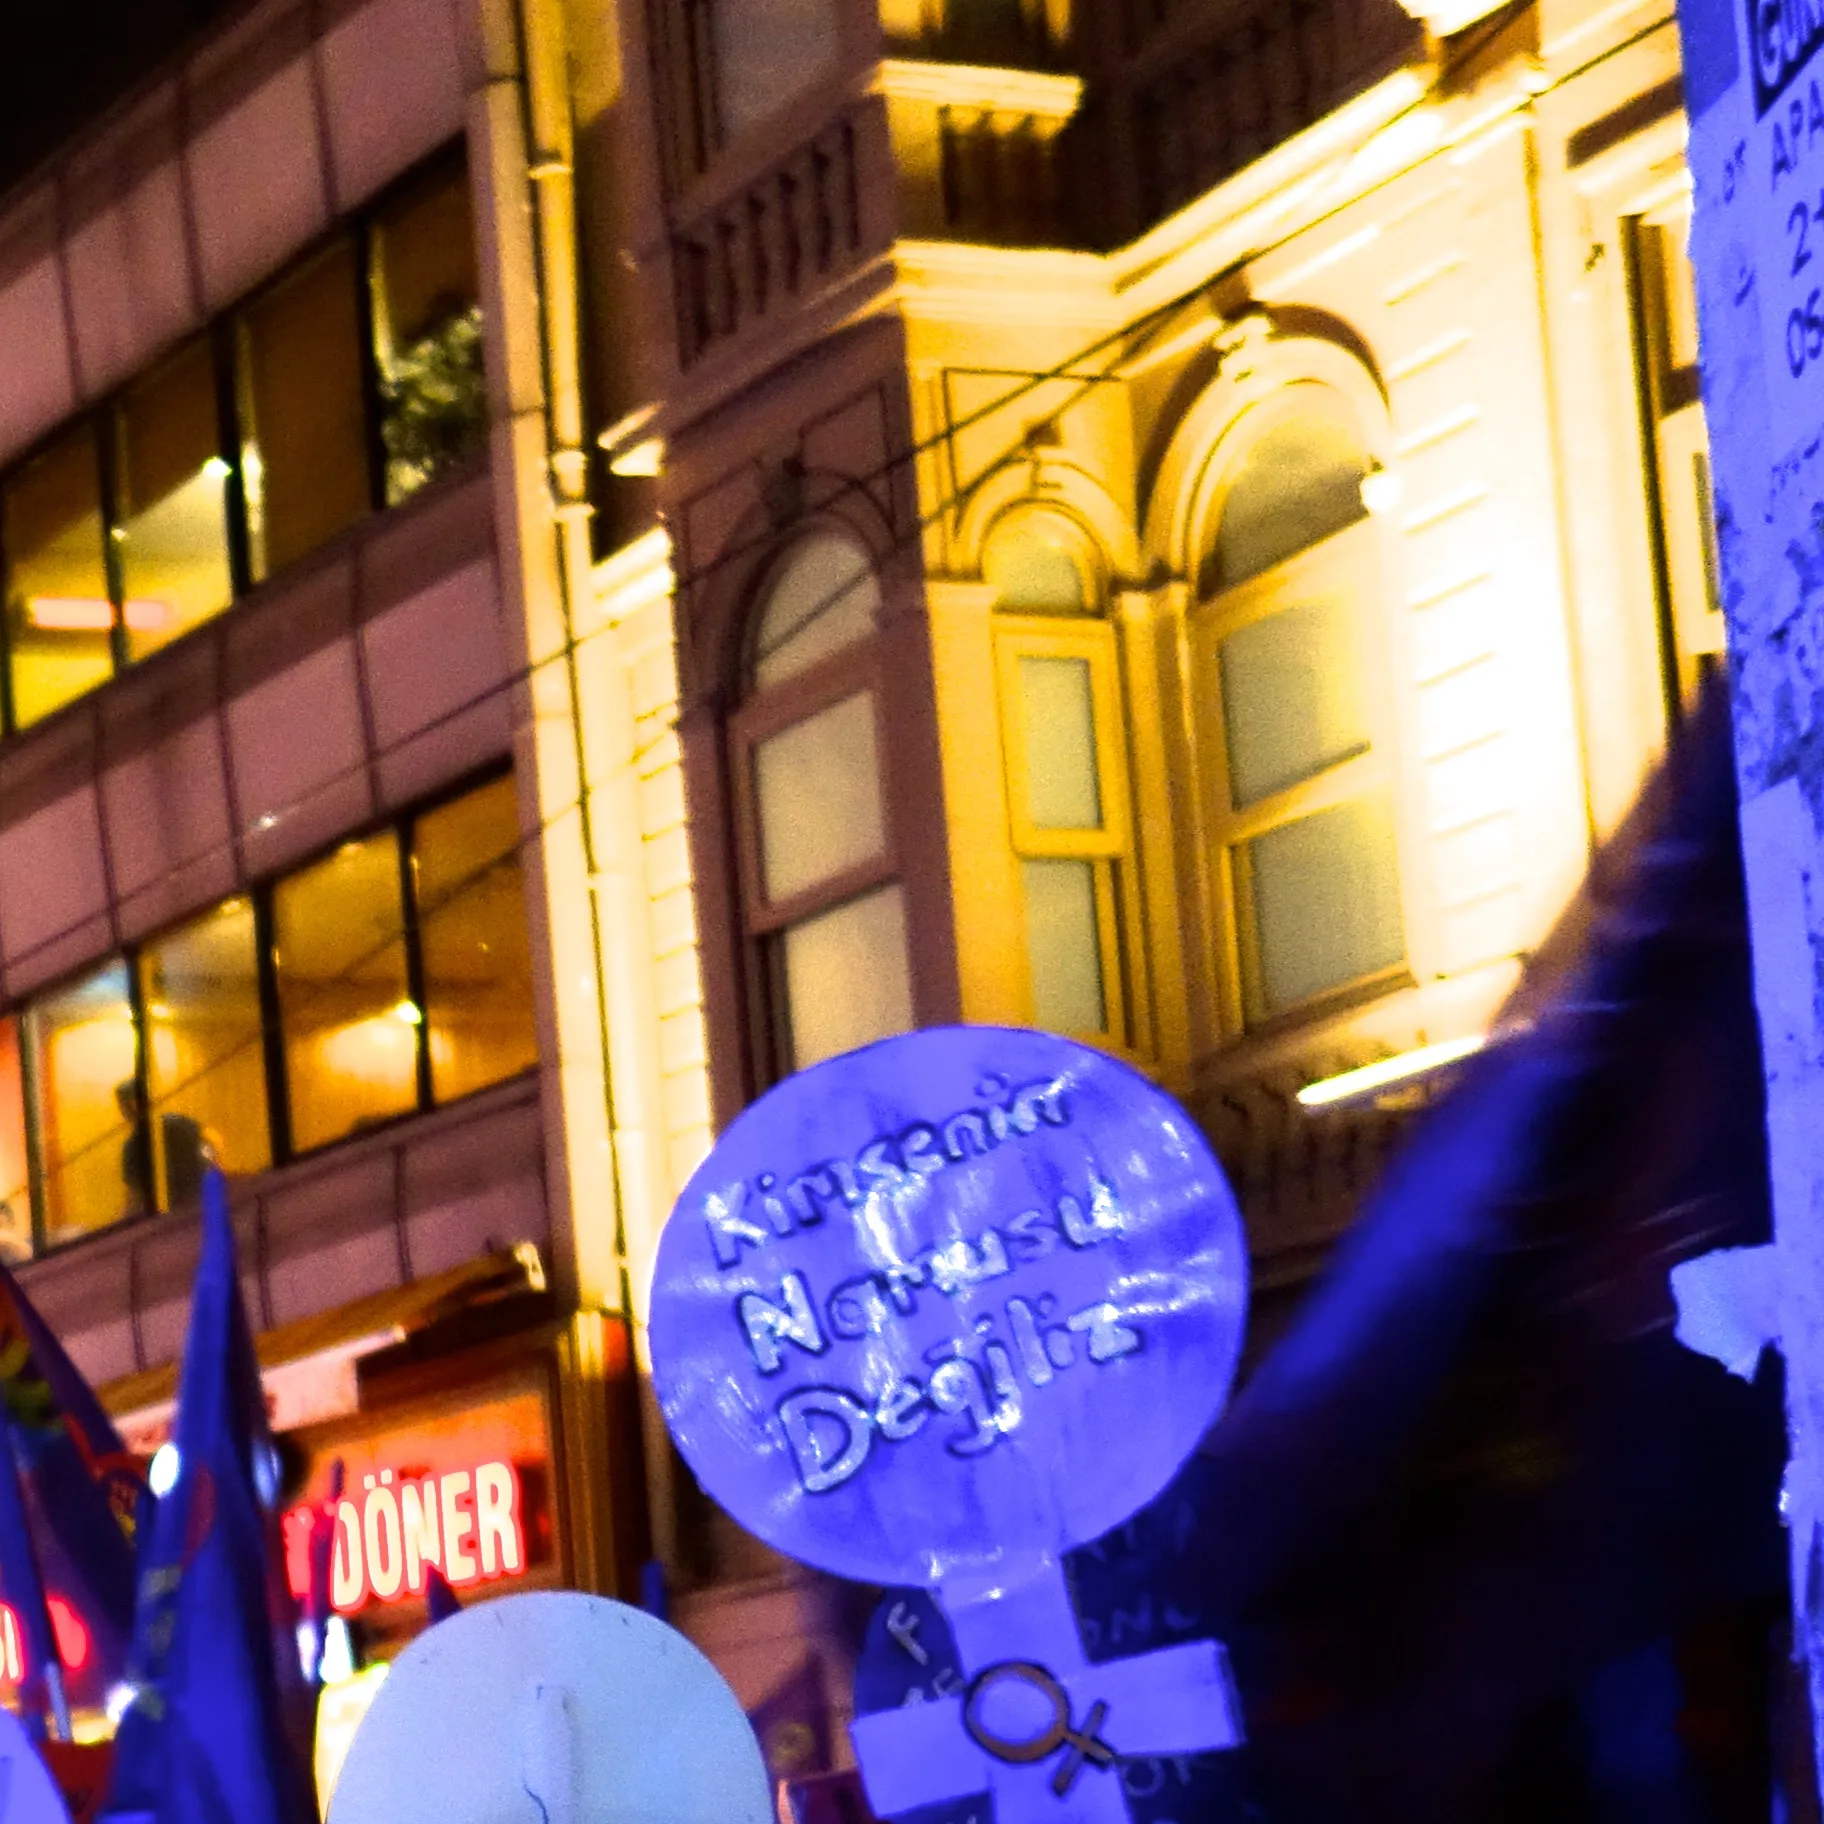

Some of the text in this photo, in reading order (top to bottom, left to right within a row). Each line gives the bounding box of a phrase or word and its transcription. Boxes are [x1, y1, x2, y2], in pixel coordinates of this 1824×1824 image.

[705, 1070, 1074, 1272] Kimsenin
[736, 1176, 1118, 1377] Namusu
[330, 1460, 521, 1609] DÖNER
